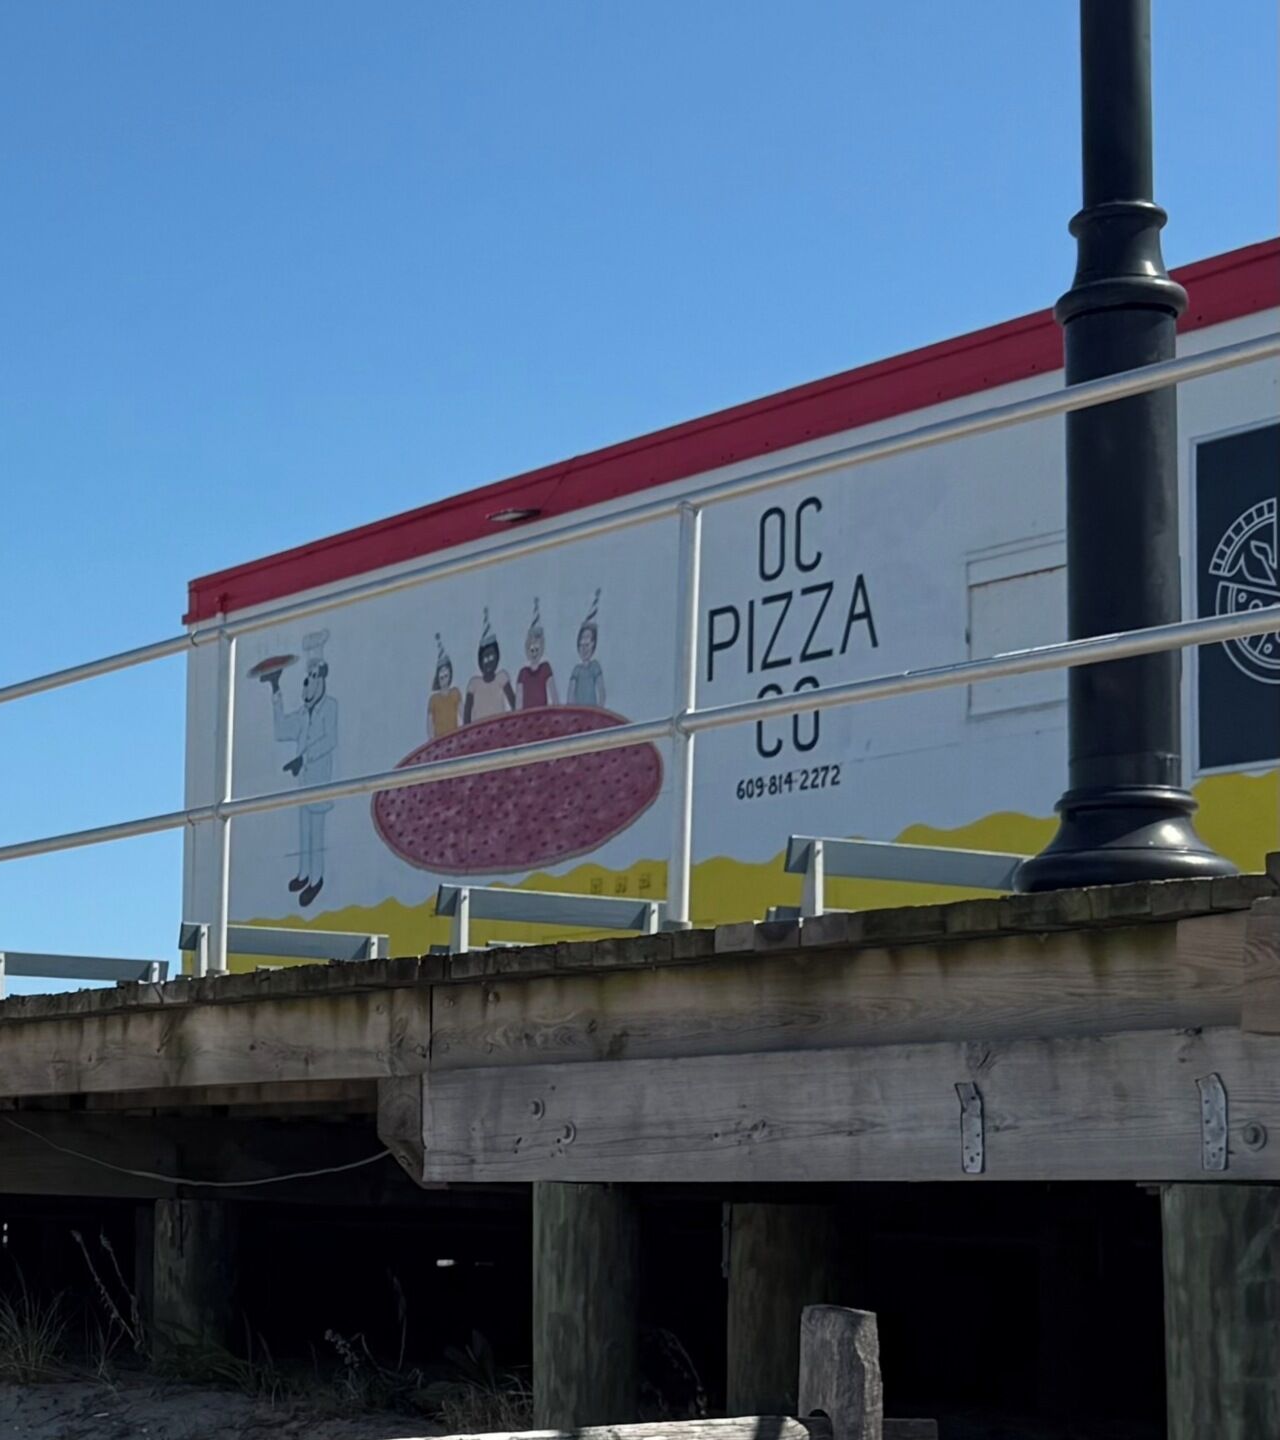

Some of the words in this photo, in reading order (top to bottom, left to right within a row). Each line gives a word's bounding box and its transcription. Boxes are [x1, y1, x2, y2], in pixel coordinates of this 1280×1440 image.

[759, 496, 822, 582] OC
[707, 573, 878, 682] PIZZA
[756, 676, 819, 758] CO
[736, 764, 841, 800] 609-814-2272
